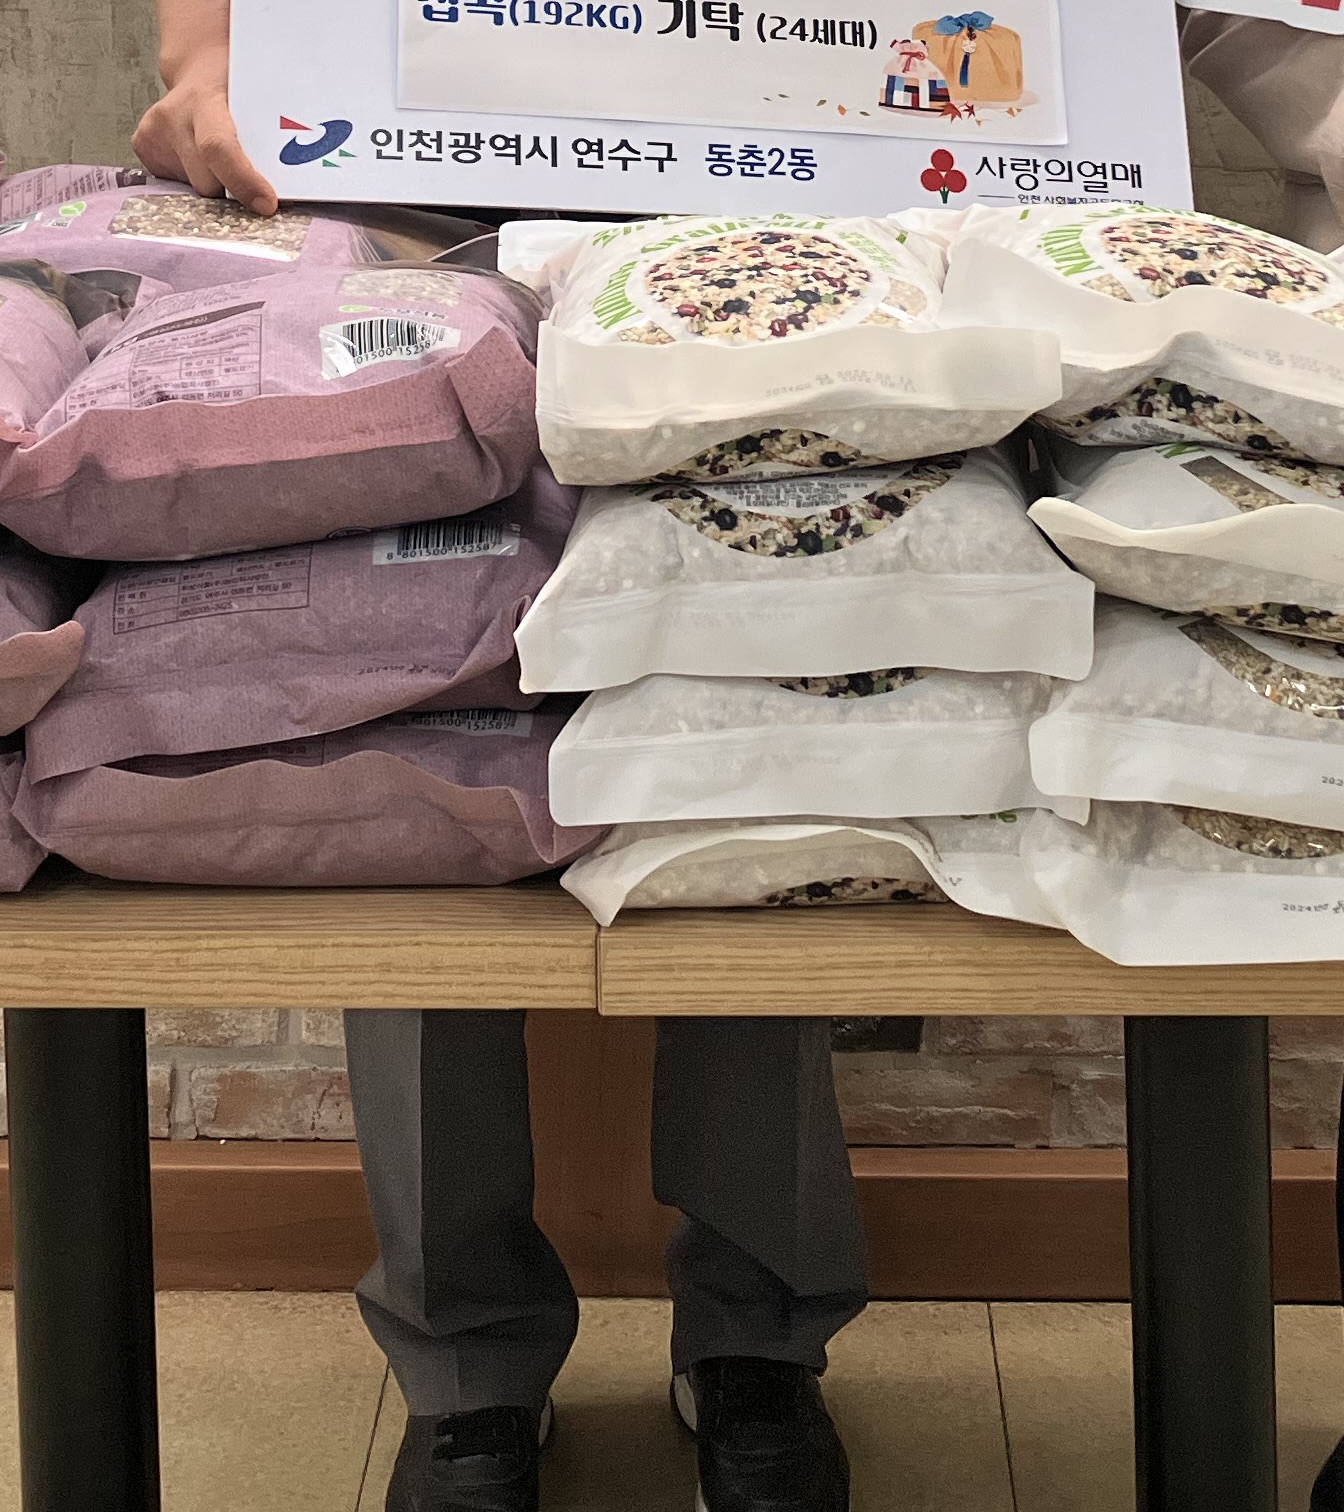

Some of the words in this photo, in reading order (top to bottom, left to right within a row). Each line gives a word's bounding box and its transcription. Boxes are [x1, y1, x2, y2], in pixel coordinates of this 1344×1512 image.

[756, 12, 878, 51] (24세대)
[369, 128, 559, 169] 인천광역시
[571, 137, 678, 174] 연수구
[703, 141, 819, 183] 동춘2동
[975, 156, 1143, 194] 사랑의열매
[1017, 194, 1041, 205] 인천
[355, 347, 393, 364] 01500
[386, 552, 394, 560] 8
[402, 547, 448, 559] 801500
[454, 543, 497, 554] 152587
